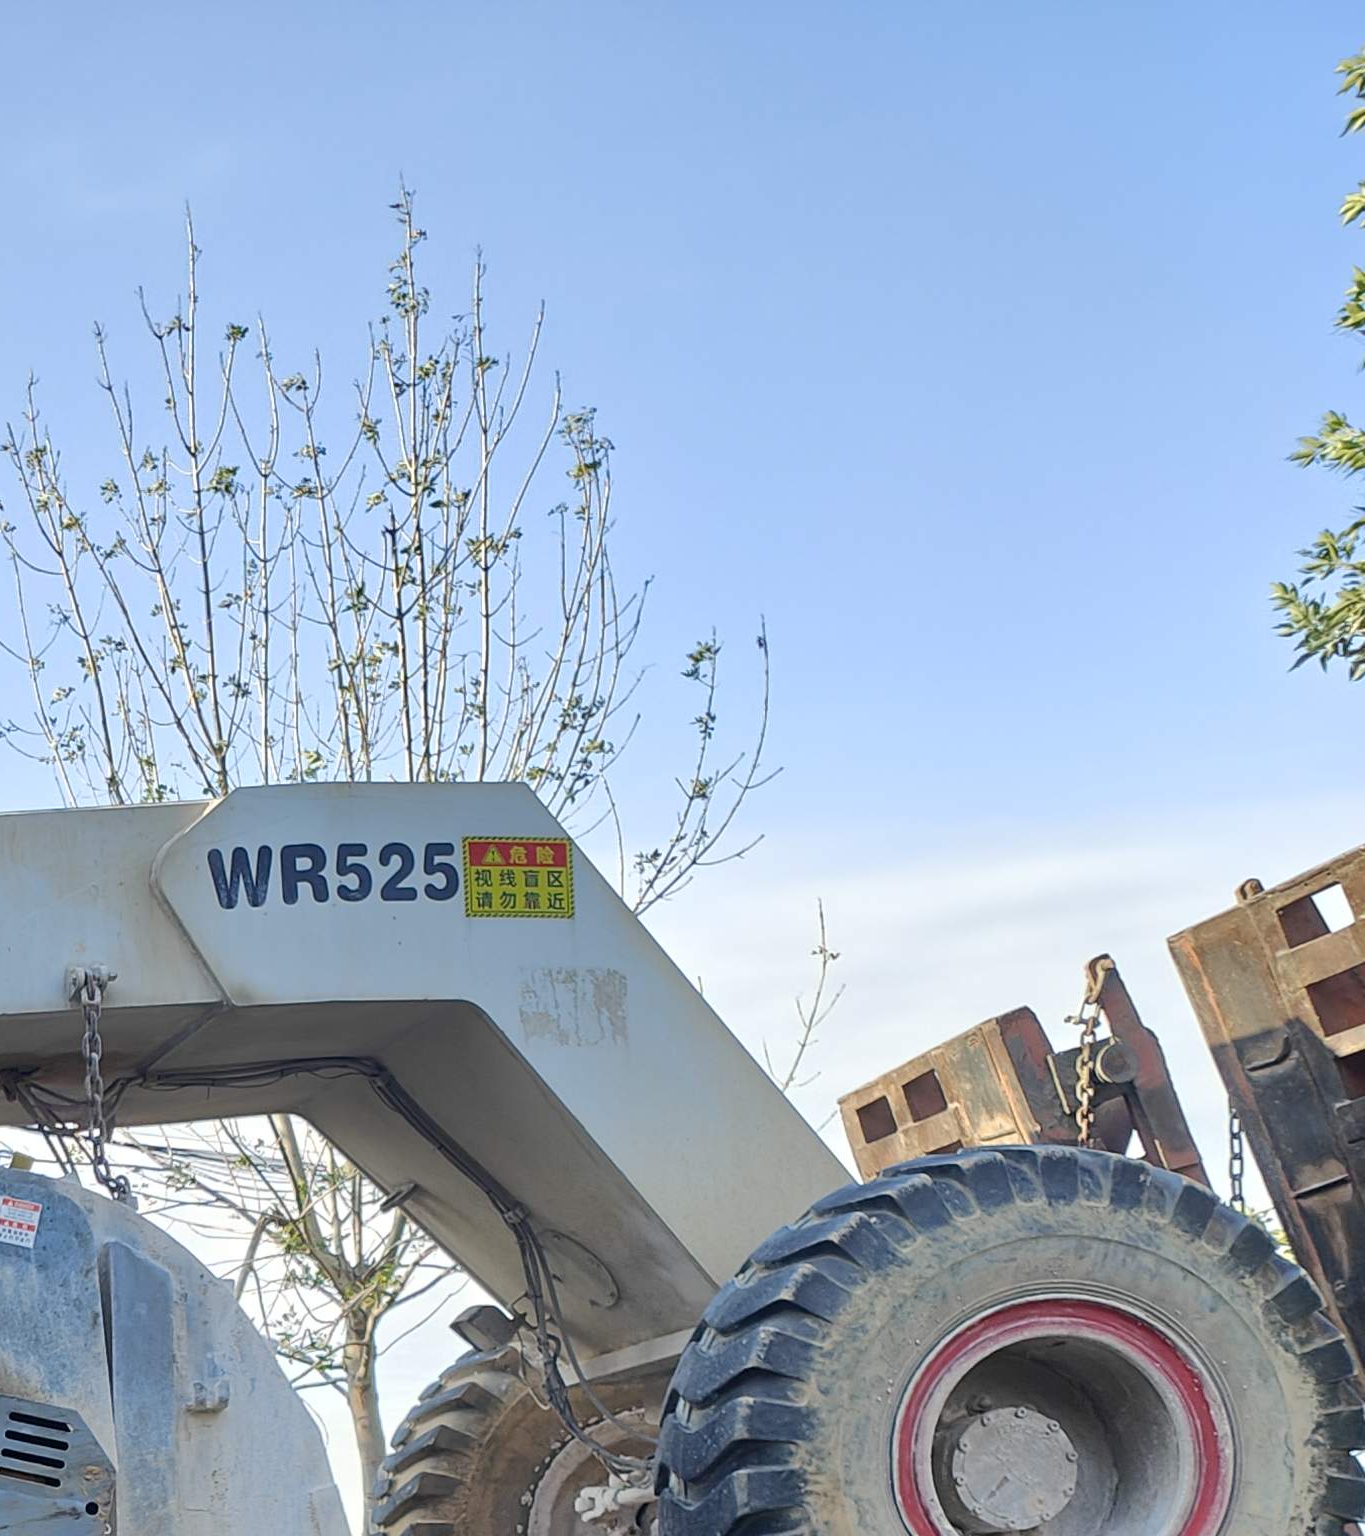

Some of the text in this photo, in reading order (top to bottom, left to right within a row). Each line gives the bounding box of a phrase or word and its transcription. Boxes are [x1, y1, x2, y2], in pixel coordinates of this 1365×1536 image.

[509, 845, 555, 865] 危险
[208, 842, 459, 909] WR525
[475, 869, 565, 889] 视线盲区
[475, 891, 565, 911] 请勿靠近
